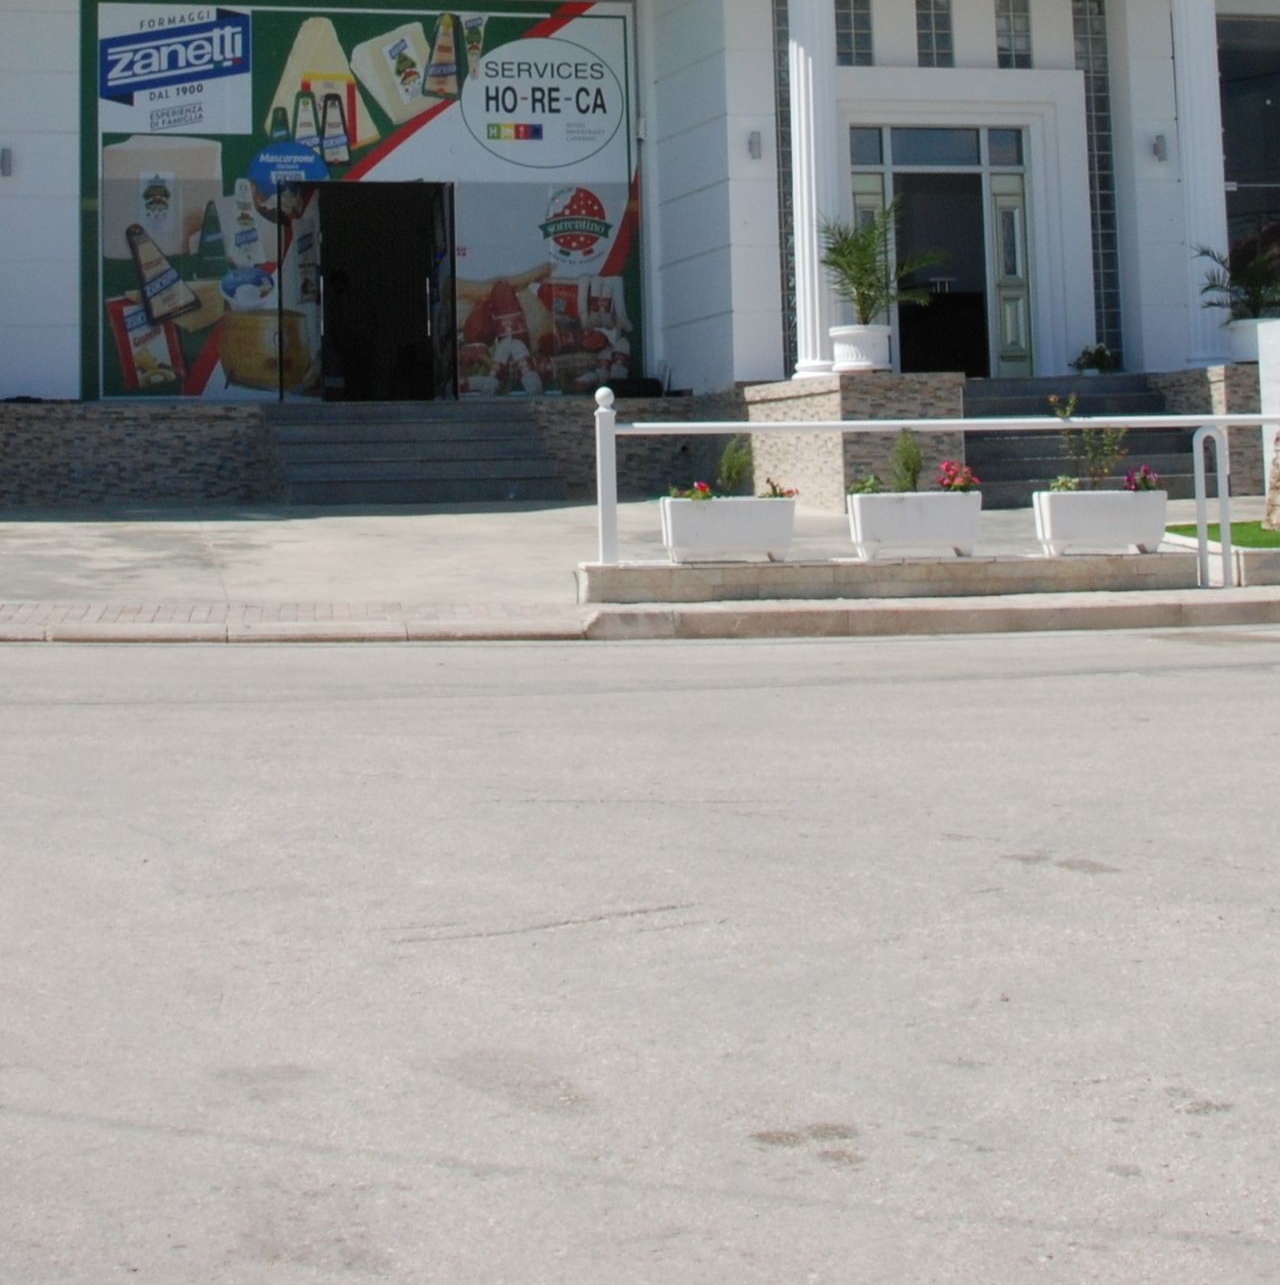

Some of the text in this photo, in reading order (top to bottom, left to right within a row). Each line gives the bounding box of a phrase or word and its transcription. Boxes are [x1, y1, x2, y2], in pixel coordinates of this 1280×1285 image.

[139, 10, 211, 31] FORMAGGI
[107, 25, 242, 80] zanetti
[484, 61, 605, 80] SERVICES
[149, 84, 204, 102] DAL 1900
